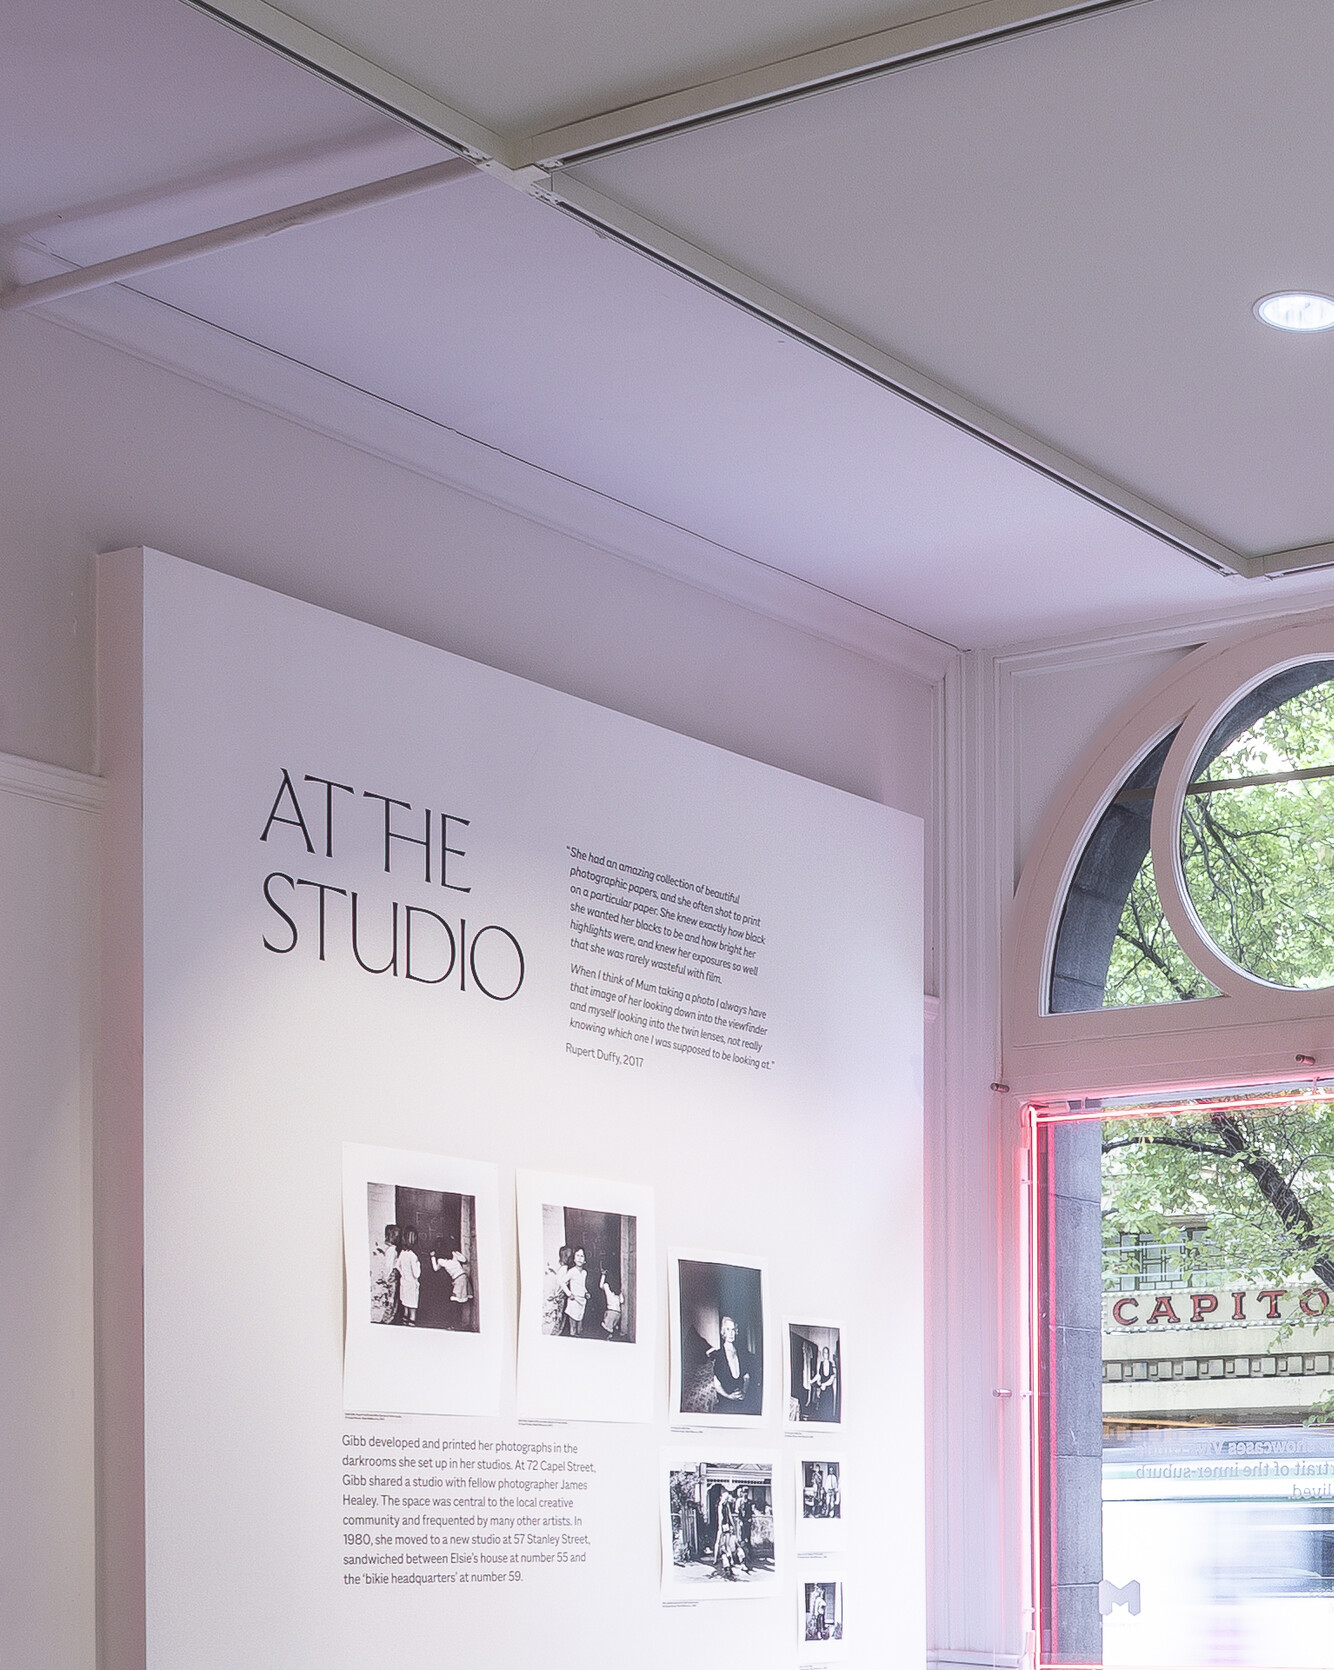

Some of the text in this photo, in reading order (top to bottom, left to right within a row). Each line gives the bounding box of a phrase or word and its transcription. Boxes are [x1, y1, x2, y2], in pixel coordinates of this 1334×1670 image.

[259, 767, 471, 893] AT THE
[587, 851, 605, 866] had
[605, 859, 617, 870] an
[618, 862, 655, 882] amazing
[655, 873, 694, 891] collection
[695, 884, 704, 893] of
[704, 884, 740, 904] beautiful
[569, 865, 760, 927] photographic papers, and she often shot to print
[262, 871, 525, 1001] STUDIO
[565, 1042, 644, 1067] Rupert Duffy, 2017
[1112, 1287, 1334, 1326] CAPITO
[341, 1434, 578, 1454] Gibb developed and printed her photographs in the
[341, 1454, 397, 1467] darkrooms
[398, 1455, 416, 1467] she
[417, 1458, 433, 1468] set
[434, 1459, 447, 1471] up
[449, 1457, 458, 1468] in
[459, 1457, 475, 1469] her
[514, 1459, 525, 1470] At
[526, 1459, 538, 1470] 72
[539, 1459, 565, 1473] Capel
[341, 1473, 587, 1491] Gibb shared a studio with fellow photographer James
[379, 1494, 400, 1506] The
[401, 1497, 430, 1508] space
[431, 1497, 451, 1506] was
[452, 1496, 485, 1507] central
[487, 1497, 497, 1507] to
[499, 1496, 514, 1507] the
[516, 1496, 537, 1507] local
[538, 1496, 573, 1508] creative
[342, 1513, 400, 1528] community
[401, 1514, 420, 1525] and
[422, 1513, 475, 1528] frequented
[476, 1514, 488, 1528] by
[489, 1517, 515, 1528] many
[516, 1515, 540, 1526] other
[574, 1515, 582, 1525] In
[374, 1533, 392, 1545] she
[394, 1533, 428, 1545] moved
[429, 1534, 440, 1544] to
[441, 1536, 448, 1544] a
[449, 1536, 470, 1544] new
[471, 1533, 501, 1544] studio
[502, 1534, 512, 1544] at
[513, 1533, 525, 1544] 57
[526, 1533, 559, 1546] Stanley
[342, 1552, 403, 1565] sandwiched
[405, 1552, 448, 1564] between
[480, 1552, 508, 1563] house
[509, 1552, 519, 1563] at
[520, 1552, 555, 1562] number
[556, 1551, 568, 1562] 55
[569, 1551, 586, 1562] and
[343, 1572, 361, 1585] the
[459, 1572, 469, 1582] at
[470, 1571, 507, 1582] number
